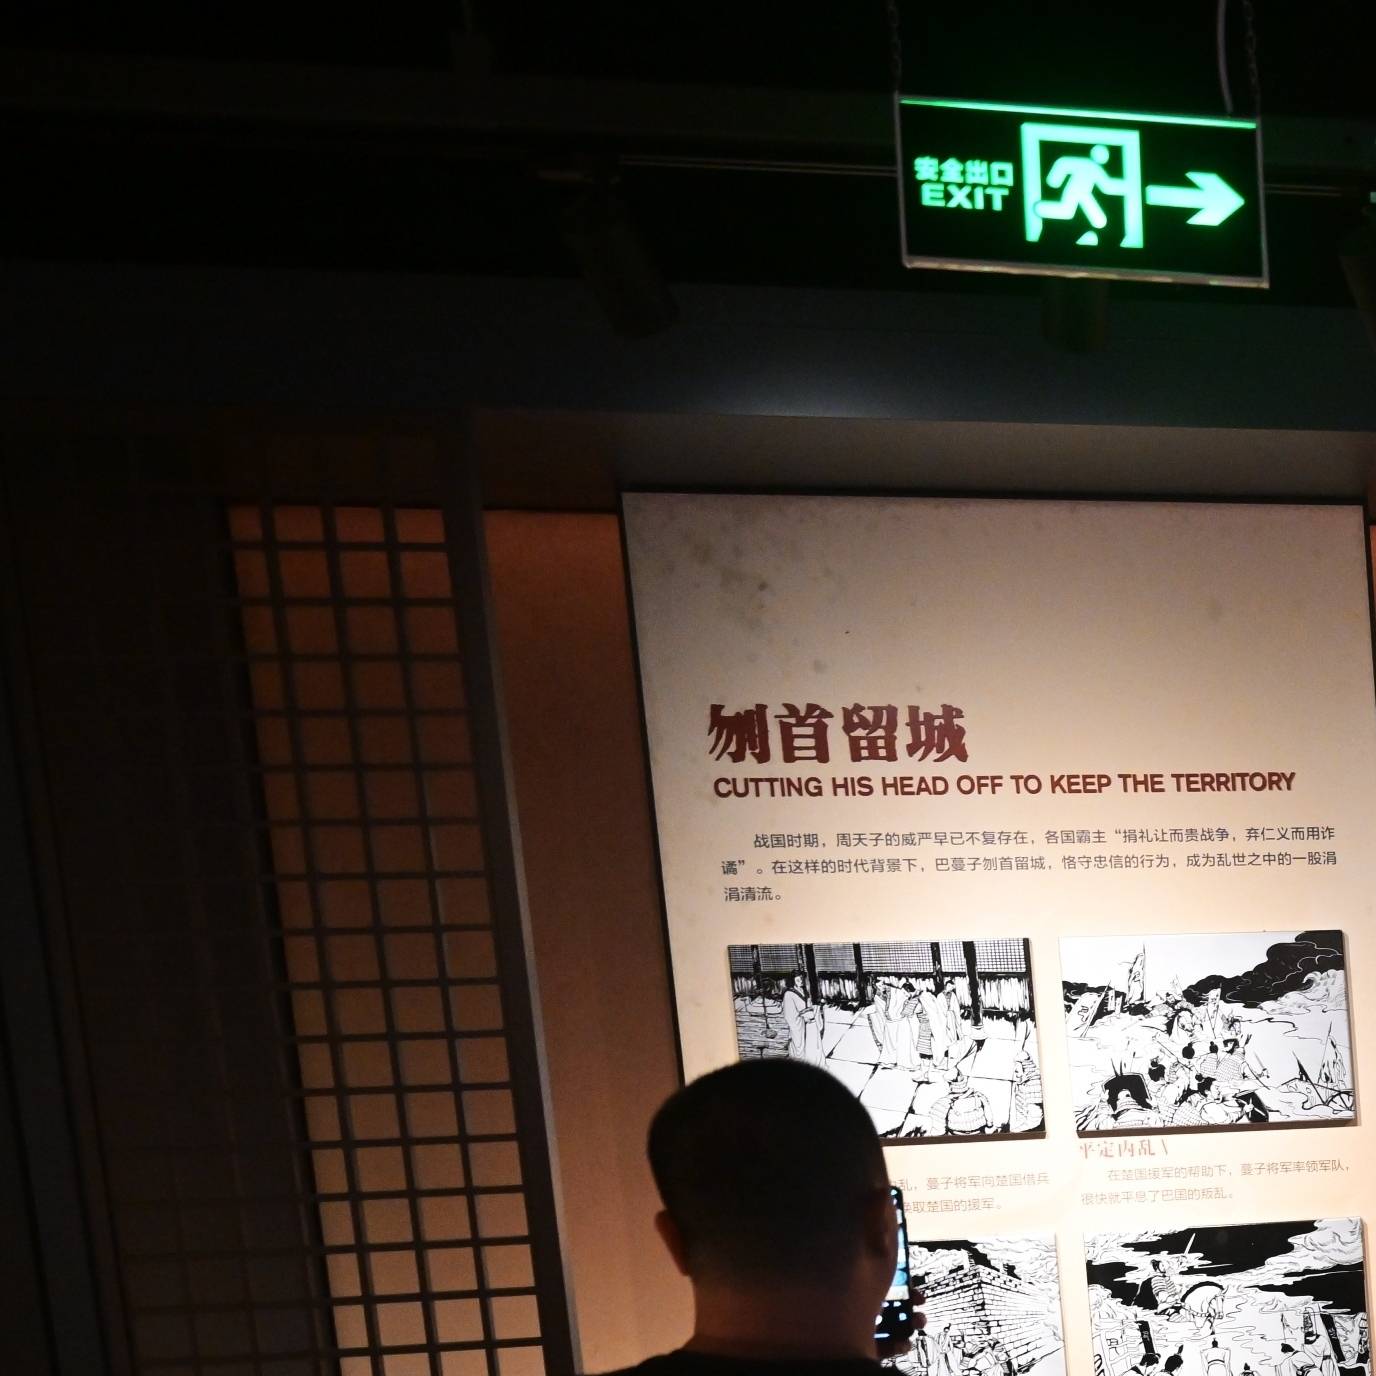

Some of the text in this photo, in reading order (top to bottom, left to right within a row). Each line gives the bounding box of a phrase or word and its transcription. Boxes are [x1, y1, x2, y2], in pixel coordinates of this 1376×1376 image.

[914, 156, 1013, 186] 安全出口
[921, 183, 1009, 211] EXIT
[706, 703, 970, 765] 刎首留城
[713, 771, 1296, 799] CUTTING HIS HEAD OFF TO KEEP THE TERRITORY
[754, 826, 1335, 849] 战国时期，周天子的威严早已不复存在，各国霸主“捐礼让而贵战争，弃仁义而用诈
[724, 886, 783, 902] 涓清流。
